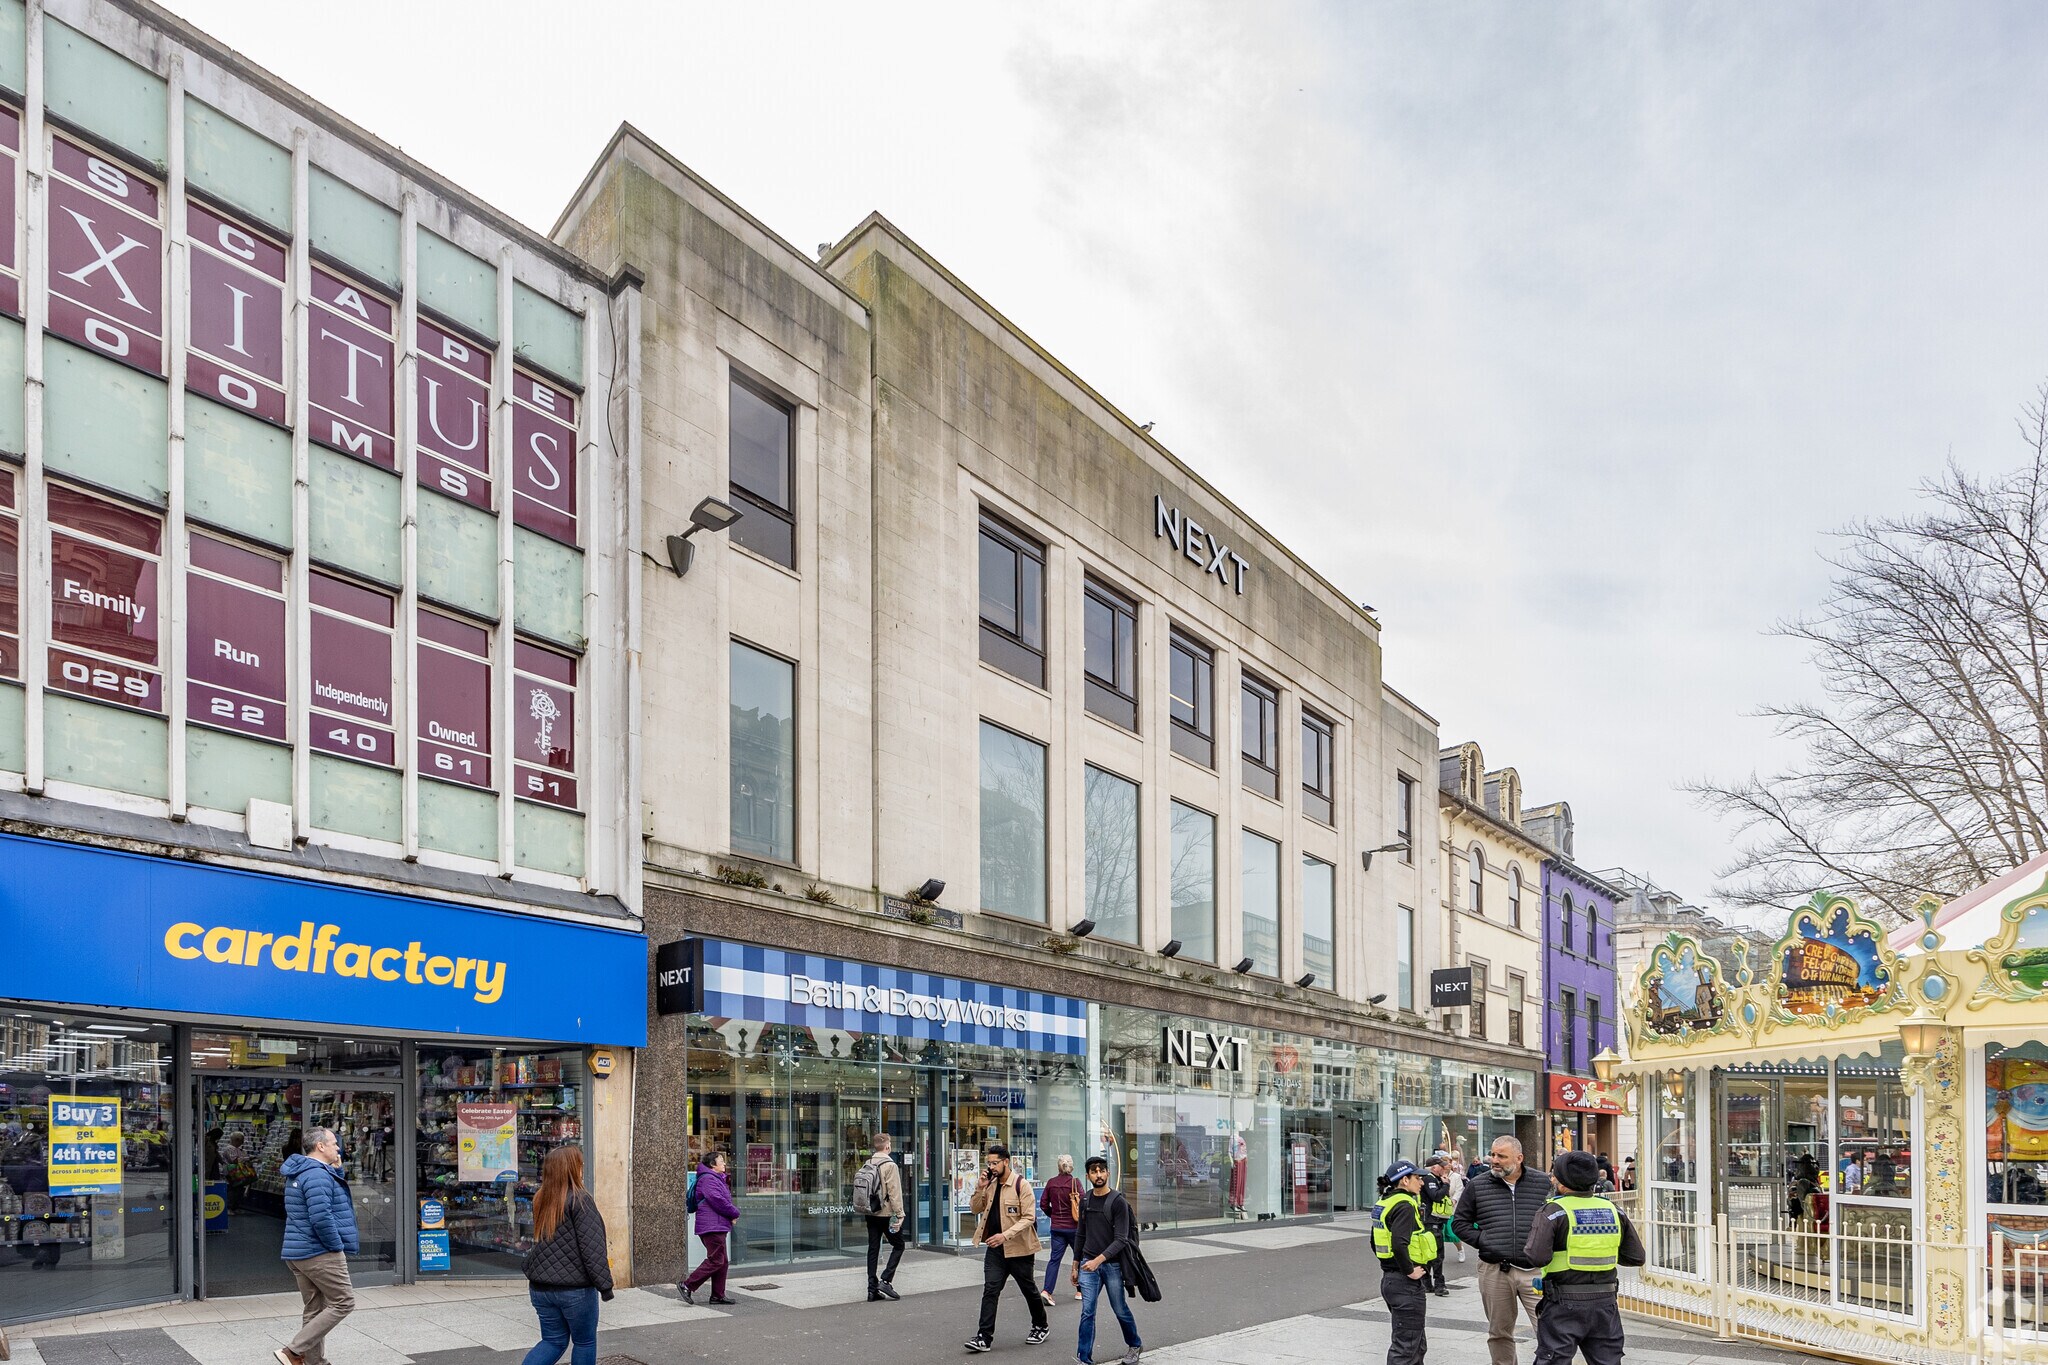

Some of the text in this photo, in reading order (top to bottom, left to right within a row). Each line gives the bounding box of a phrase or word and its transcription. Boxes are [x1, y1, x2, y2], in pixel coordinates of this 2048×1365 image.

[1154, 494, 1249, 596] NEXT
[63, 578, 478, 748] Family Run Independently Owned.
[62, 661, 149, 698] 029
[887, 898, 937, 916] QUEEN STRET
[164, 921, 507, 1004] cardfactory
[659, 966, 692, 988] NEXT
[1435, 981, 1469, 993] NEXT
[790, 973, 1027, 1032] Bath & Body Works
[1162, 1026, 1249, 1072] NEXT
[597, 1057, 611, 1067] ADT
[1473, 1072, 1516, 1101] NEXT
[57, 1104, 112, 1126] Buy 3
[76, 1130, 94, 1140] get
[53, 1147, 116, 1161] 4th free
[808, 1206, 824, 1215] Bath
[823, 1206, 830, 1214] &
[829, 1205, 846, 1214] Body
